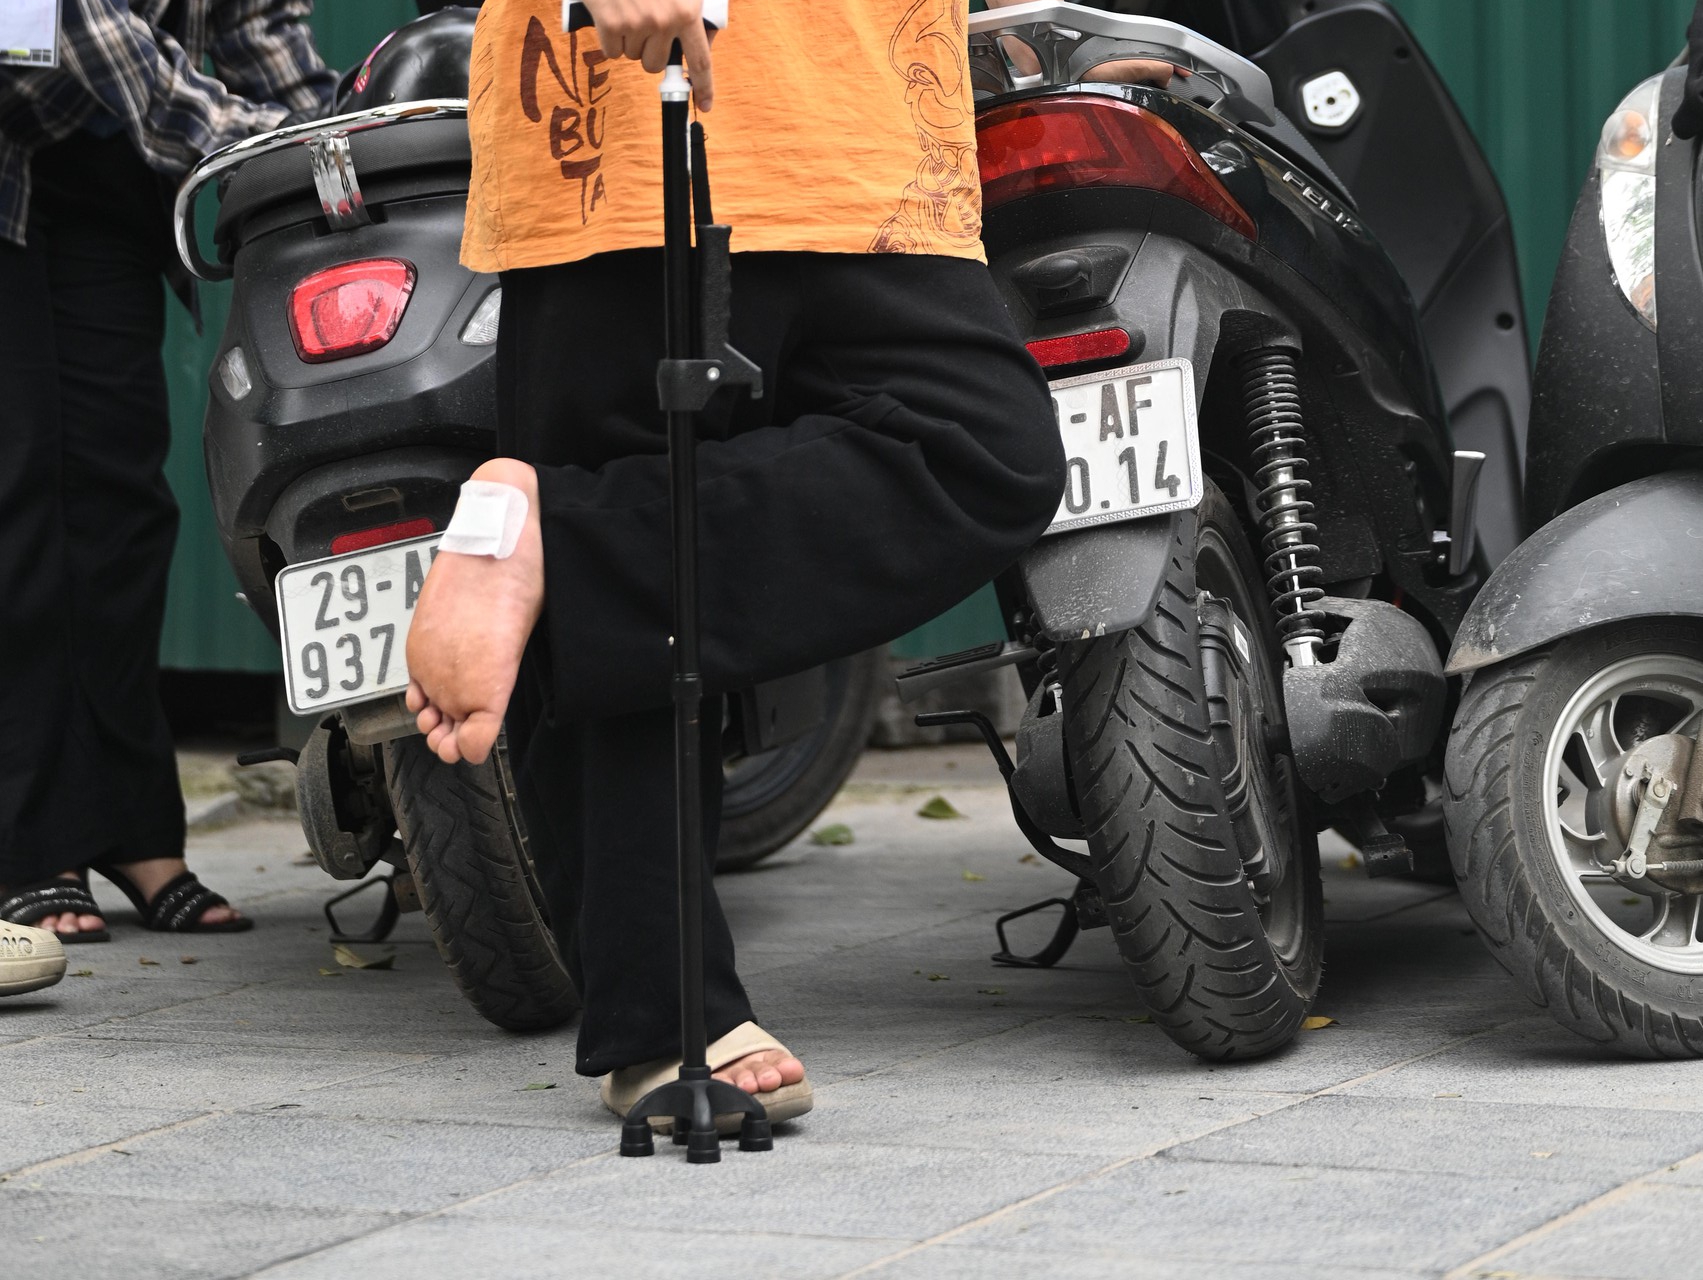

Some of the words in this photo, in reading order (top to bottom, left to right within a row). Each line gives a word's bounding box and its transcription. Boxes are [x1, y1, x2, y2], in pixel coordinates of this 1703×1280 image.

[520, 15, 612, 124] NE
[550, 105, 606, 160] BU
[560, 153, 608, 226] TA
[1050, 375, 1153, 442] -AF
[310, 546, 438, 631] 29-A
